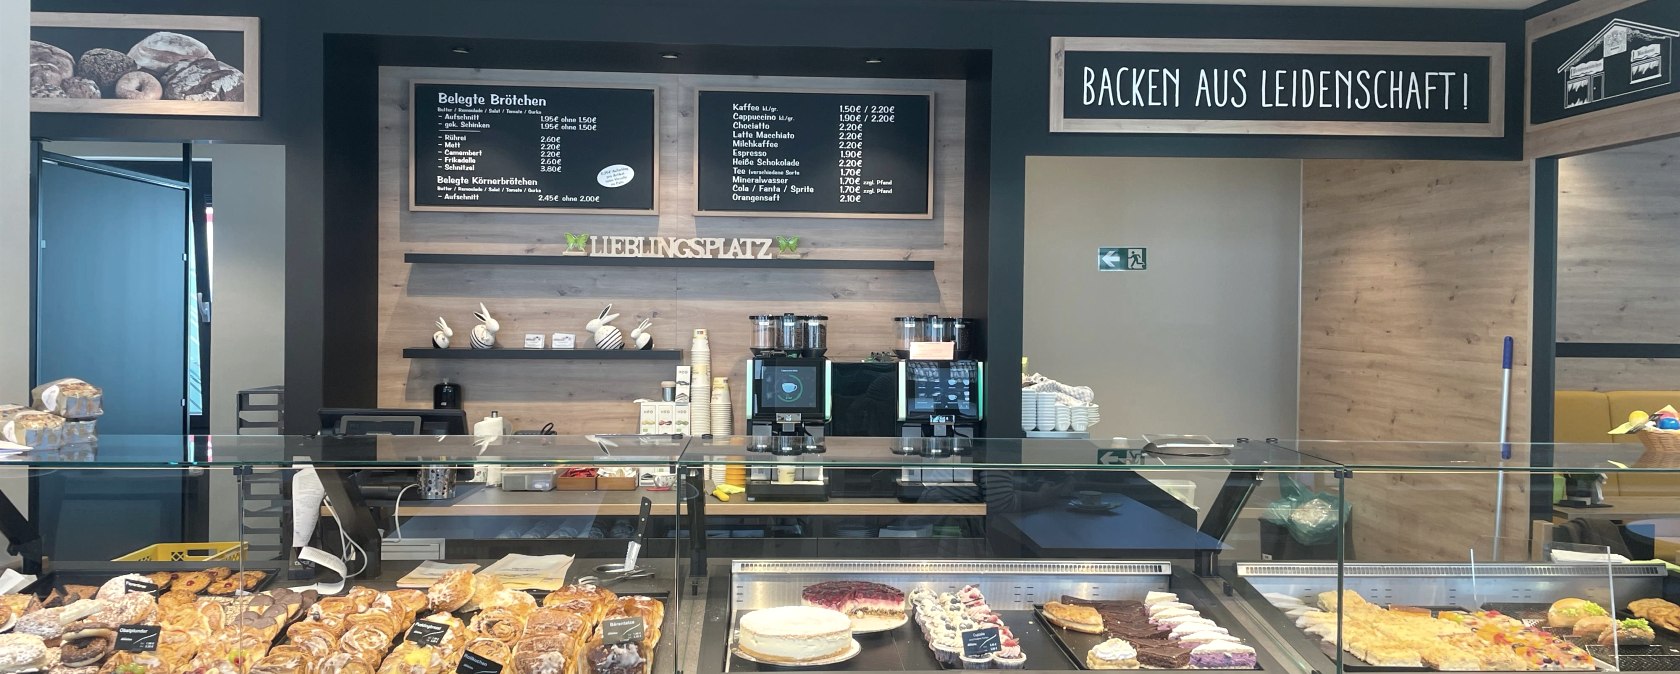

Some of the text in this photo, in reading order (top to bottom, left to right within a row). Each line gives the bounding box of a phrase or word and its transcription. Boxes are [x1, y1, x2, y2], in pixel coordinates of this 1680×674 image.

[1082, 66, 1180, 107] BACKEN
[1195, 68, 1247, 109] AUS
[438, 93, 546, 107] Belegte Brötchen
[871, 106, 894, 114] 2.20€
[733, 113, 776, 122] Cappuccino
[871, 115, 894, 123] 2.20€
[733, 140, 778, 148] Milchkaffee
[733, 150, 767, 158] Espresso
[437, 176, 538, 186] Belegte Körnerbrötchen
[791, 186, 814, 194] Sprite
[840, 186, 860, 194] 1.70€
[732, 194, 780, 202] Orangensaft
[590, 235, 772, 259] LIEBLINGSPLATZ
